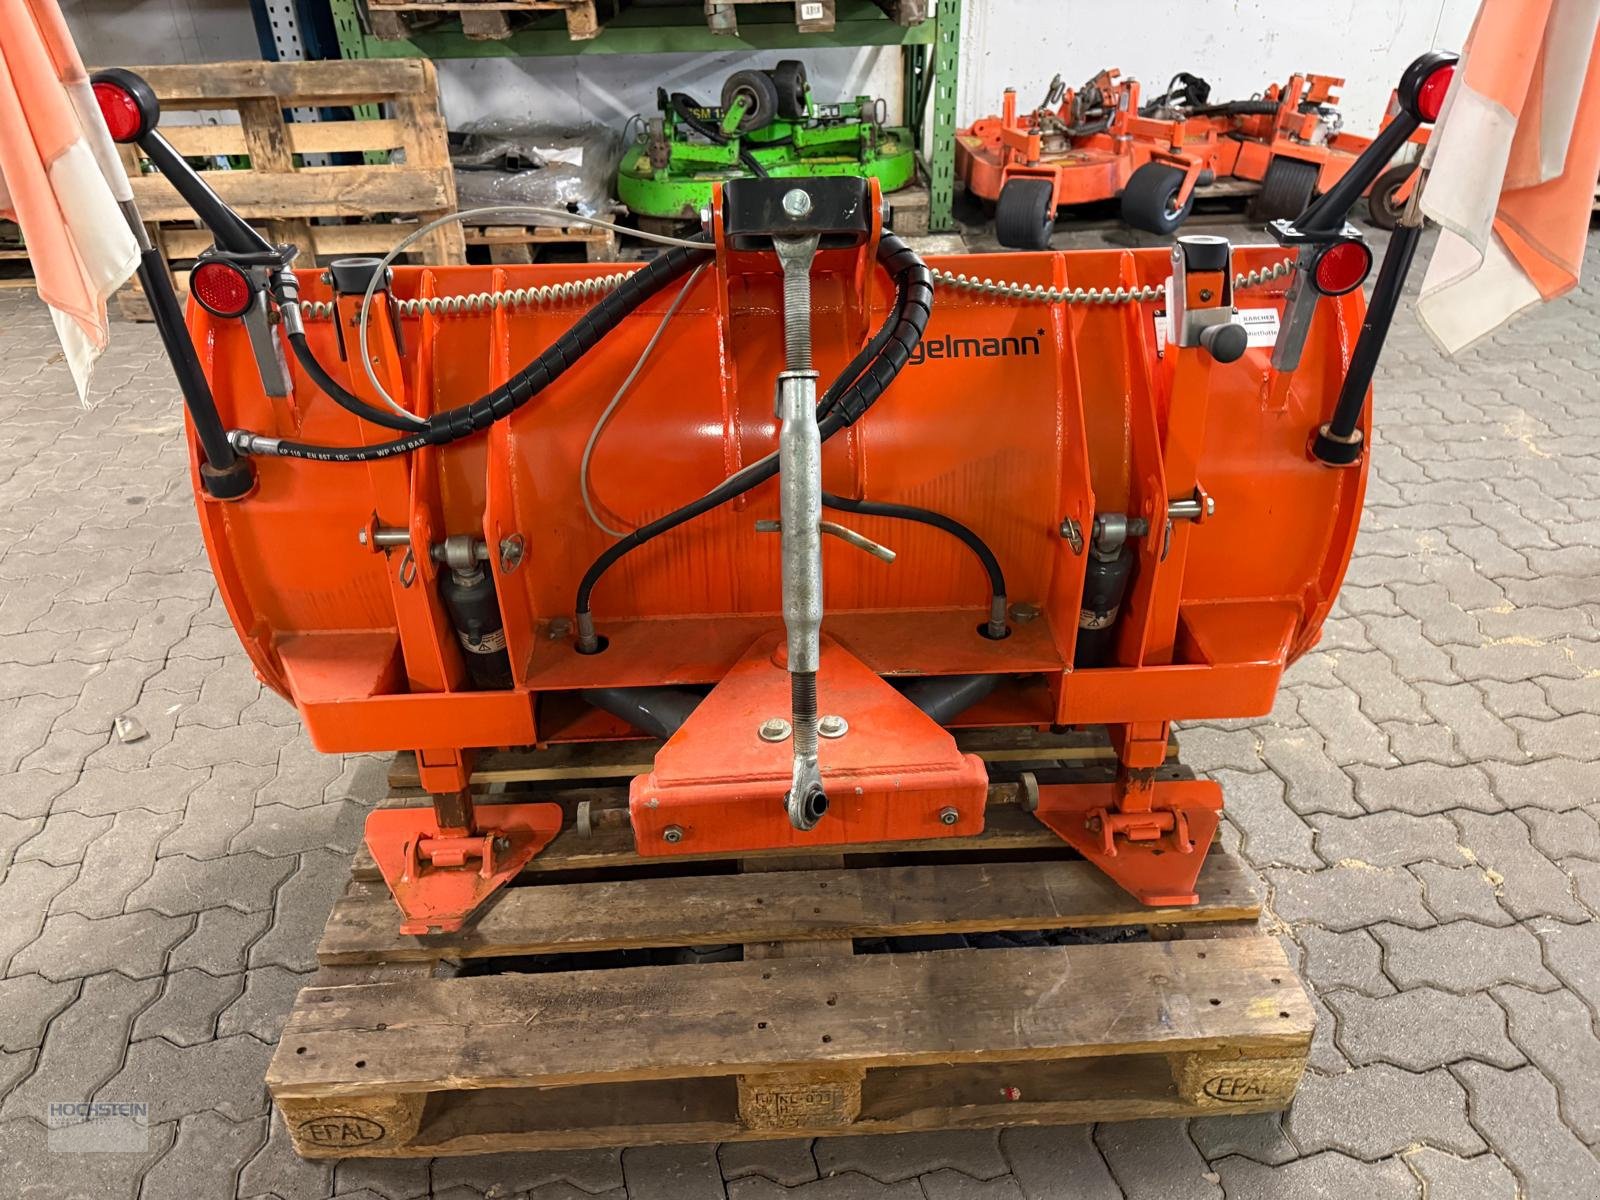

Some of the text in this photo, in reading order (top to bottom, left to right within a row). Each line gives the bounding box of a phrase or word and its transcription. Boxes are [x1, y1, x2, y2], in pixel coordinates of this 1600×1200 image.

[306, 451, 317, 459] EN
[376, 448, 390, 457] WP
[407, 438, 427, 449] BAR
[309, 1122, 375, 1141] EPAL
